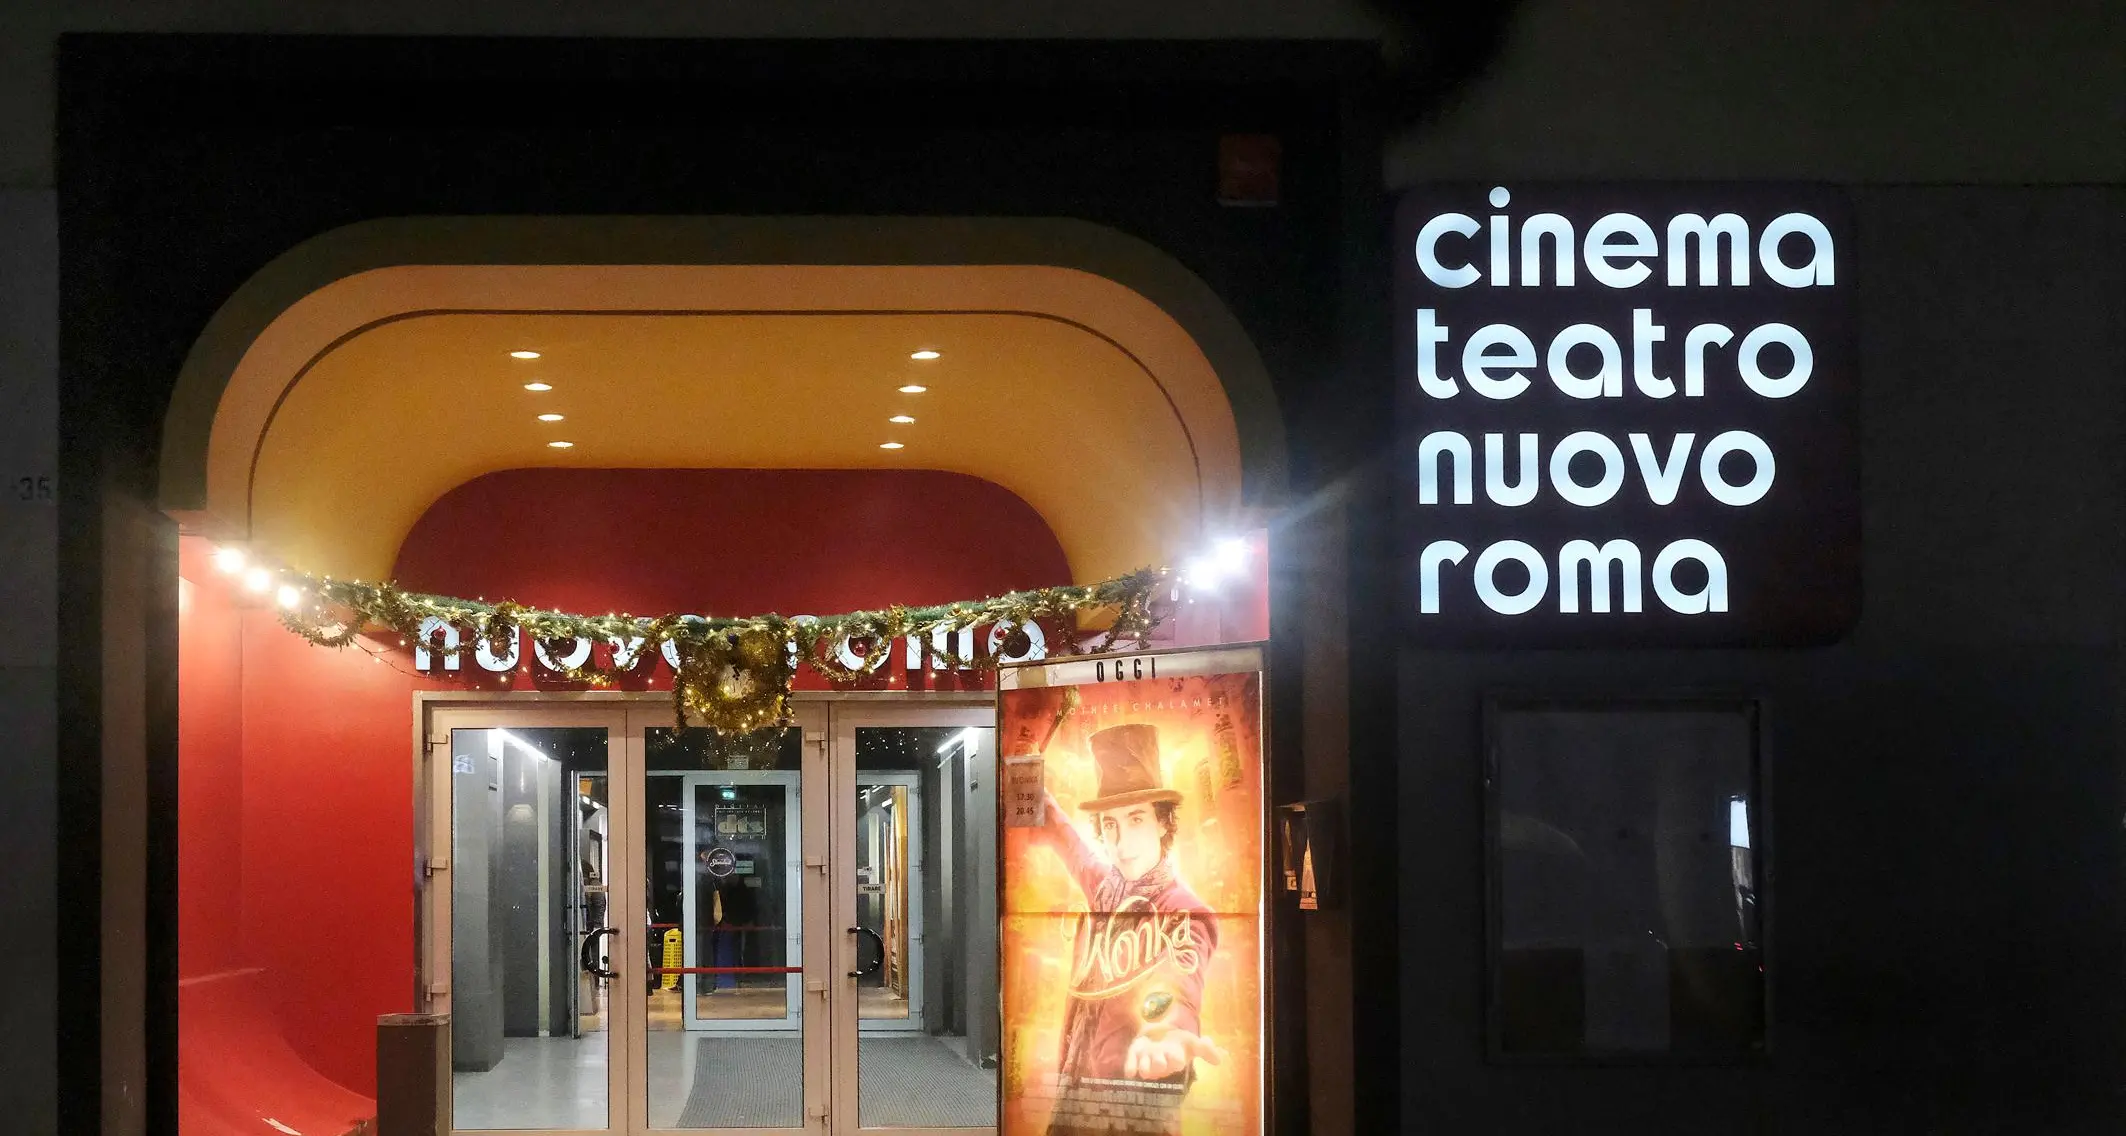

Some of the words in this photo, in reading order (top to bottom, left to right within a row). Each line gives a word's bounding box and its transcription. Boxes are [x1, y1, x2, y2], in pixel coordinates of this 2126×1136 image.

[1416, 187, 1835, 289] cinema
[1417, 308, 1814, 399] teatro
[1418, 430, 1776, 507] nuovo
[1420, 539, 1729, 615] roma
[1096, 657, 1156, 683] OGGI
[1132, 697, 1223, 713] CHALAMET
[1060, 895, 1199, 998] Wonka
